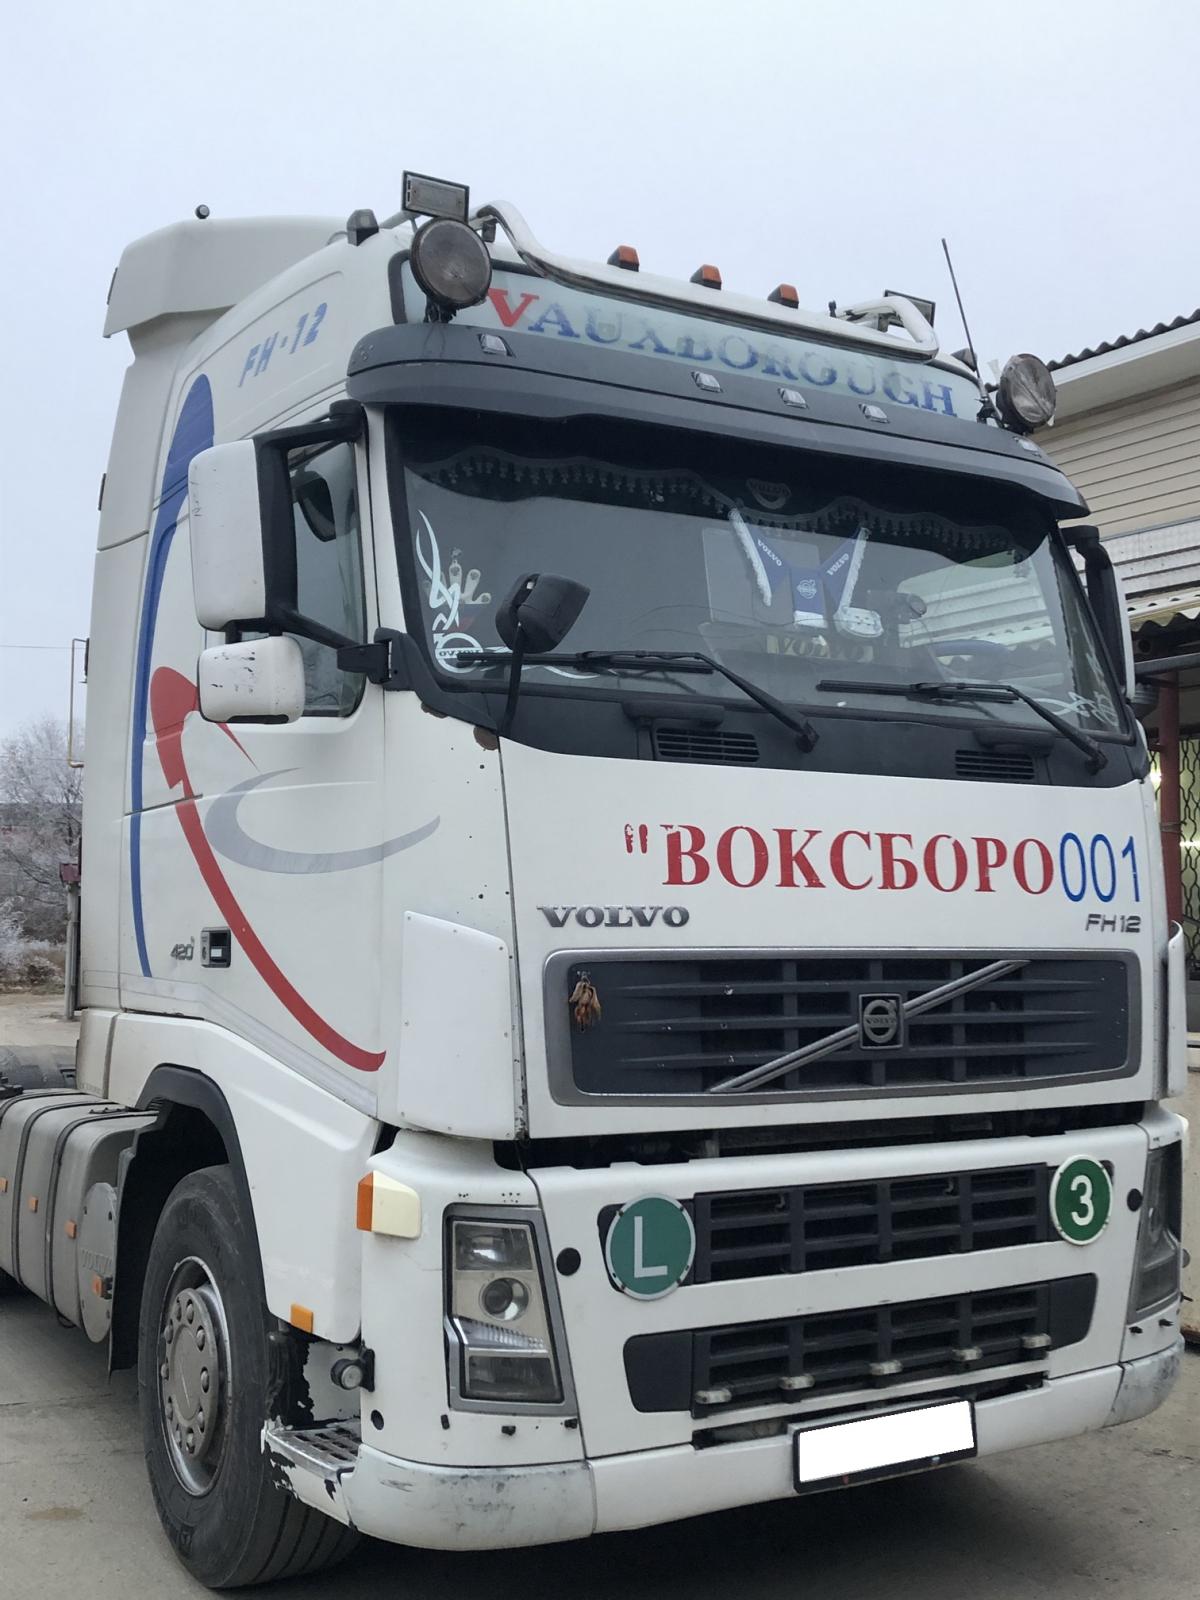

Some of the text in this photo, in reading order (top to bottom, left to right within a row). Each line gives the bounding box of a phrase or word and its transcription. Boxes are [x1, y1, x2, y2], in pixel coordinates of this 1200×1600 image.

[757, 539, 782, 567] VOLVO
[1059, 832, 1140, 902] 001
[537, 905, 690, 928] VOLVO
[170, 943, 194, 961] 420
[1070, 1174, 1095, 1226] 3
[633, 1215, 668, 1278] L
